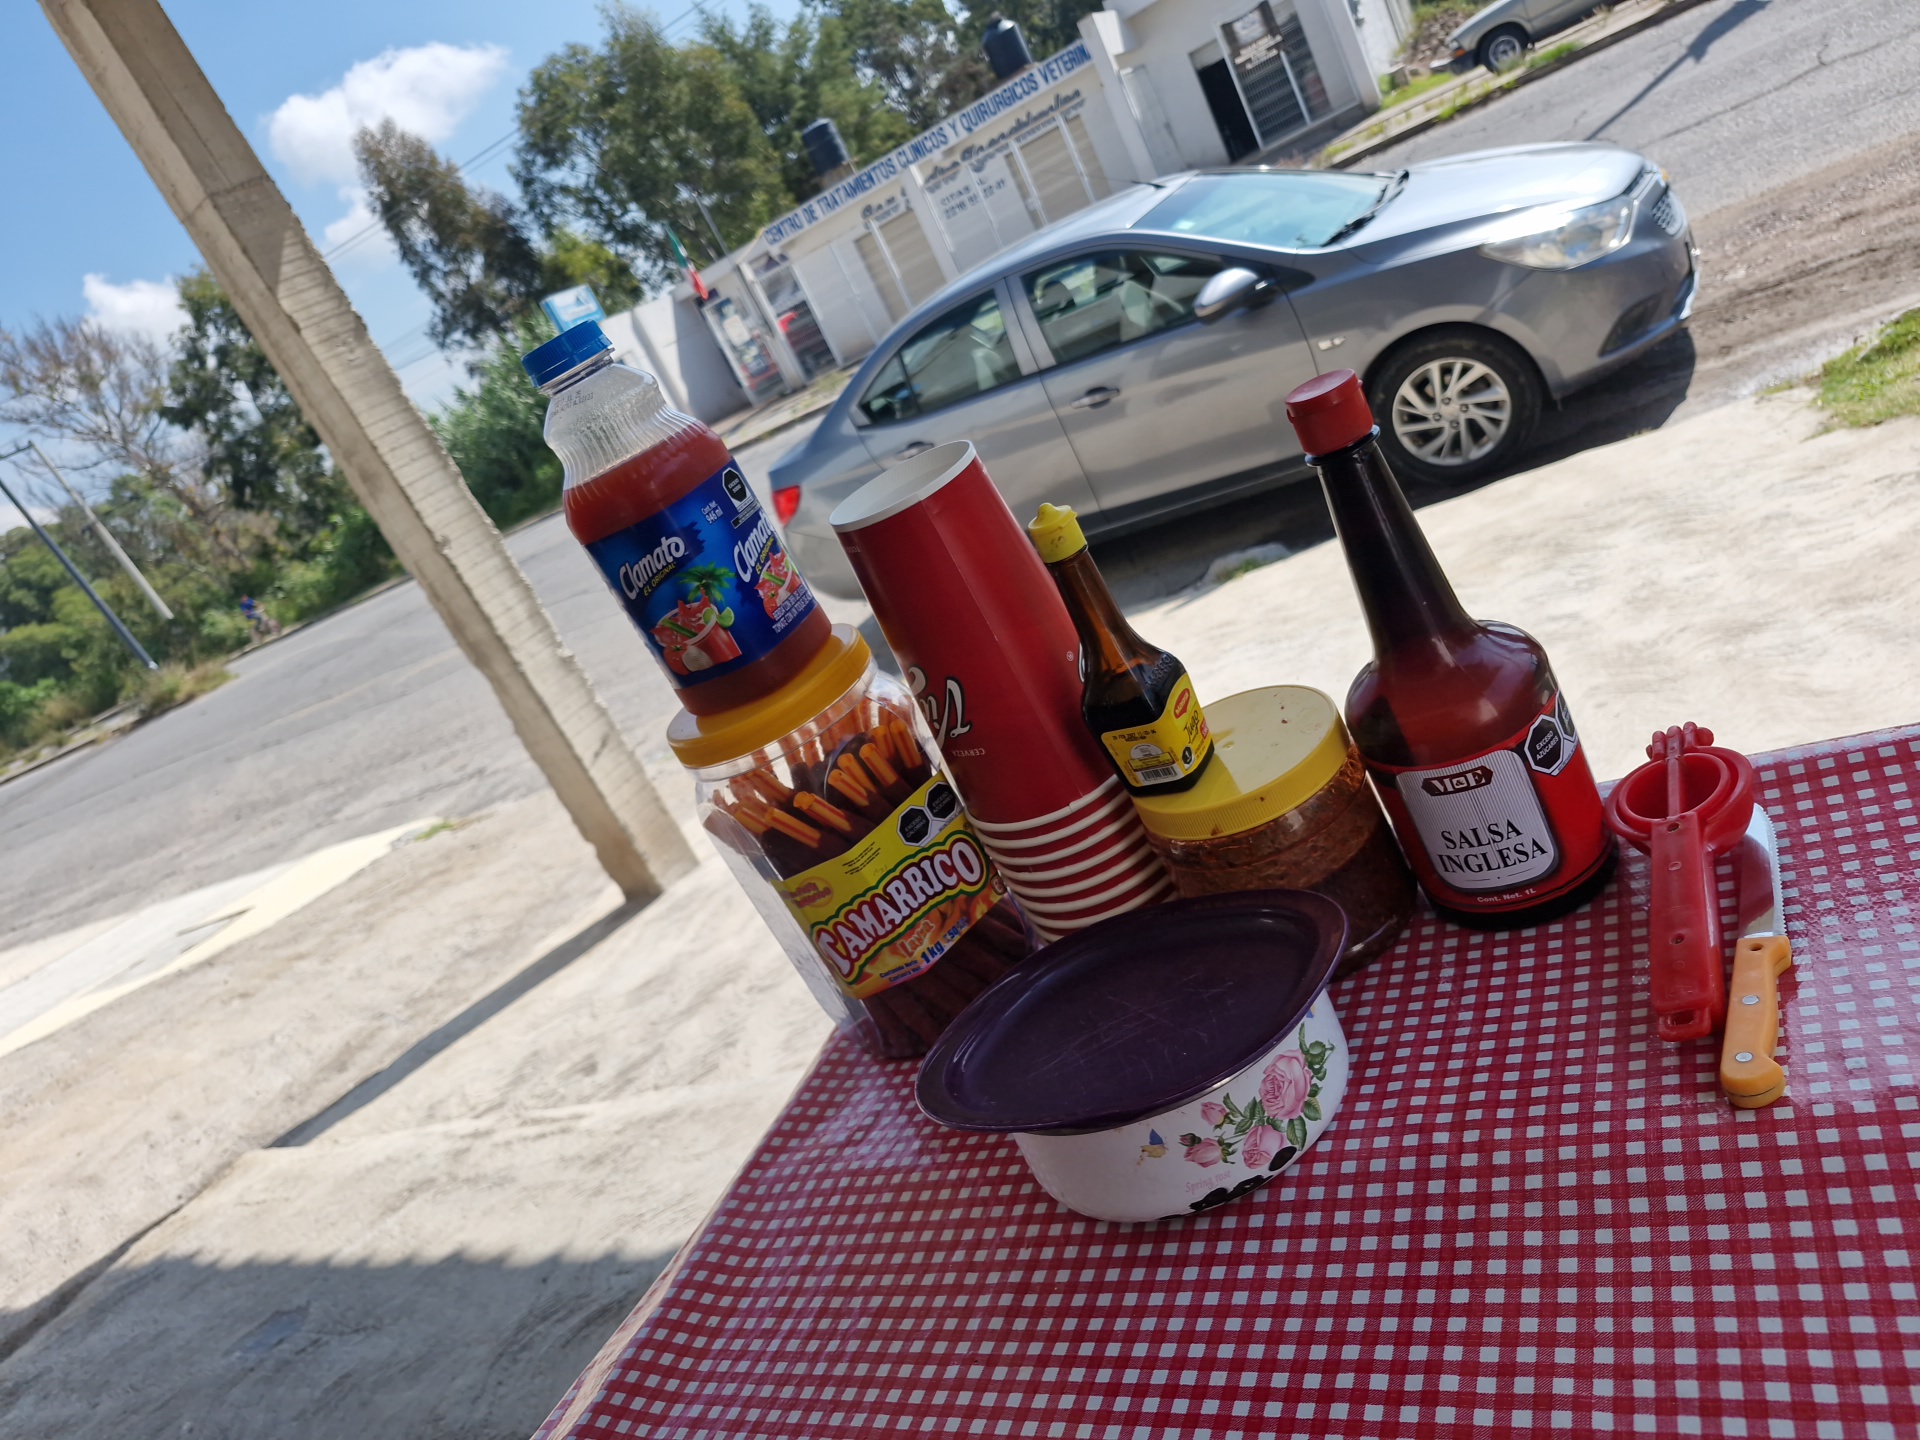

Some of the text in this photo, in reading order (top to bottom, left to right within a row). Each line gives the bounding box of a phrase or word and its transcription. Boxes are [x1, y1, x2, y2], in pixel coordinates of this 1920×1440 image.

[764, 213, 803, 245] CENTRO
[804, 204, 818, 223] DE
[819, 160, 897, 216] TRATAMIENTOS
[897, 127, 948, 169] CLINICOS
[950, 119, 960, 137] Y
[960, 74, 1038, 133] QUIRURGICOS
[705, 510, 718, 525] 946
[715, 505, 724, 518] ml
[619, 536, 685, 600] Clamato
[643, 562, 677, 597] EL ORIGINAL
[755, 564, 762, 575] EL
[1183, 710, 1199, 744] Jugo
[1536, 731, 1554, 750] EXCESO
[1536, 736, 1559, 760] AZÚCARES
[952, 748, 986, 758] CERVEZA
[932, 791, 948, 807] EXCESO
[905, 816, 921, 832] EXCESO
[1441, 819, 1523, 850] SALSA
[1437, 838, 1548, 873] INGLESA
[817, 840, 981, 975] CAMARRICO
[1477, 893, 1501, 903] Cont.
[1503, 891, 1522, 900] Net.
[1185, 1170, 1232, 1195] Spring rose
